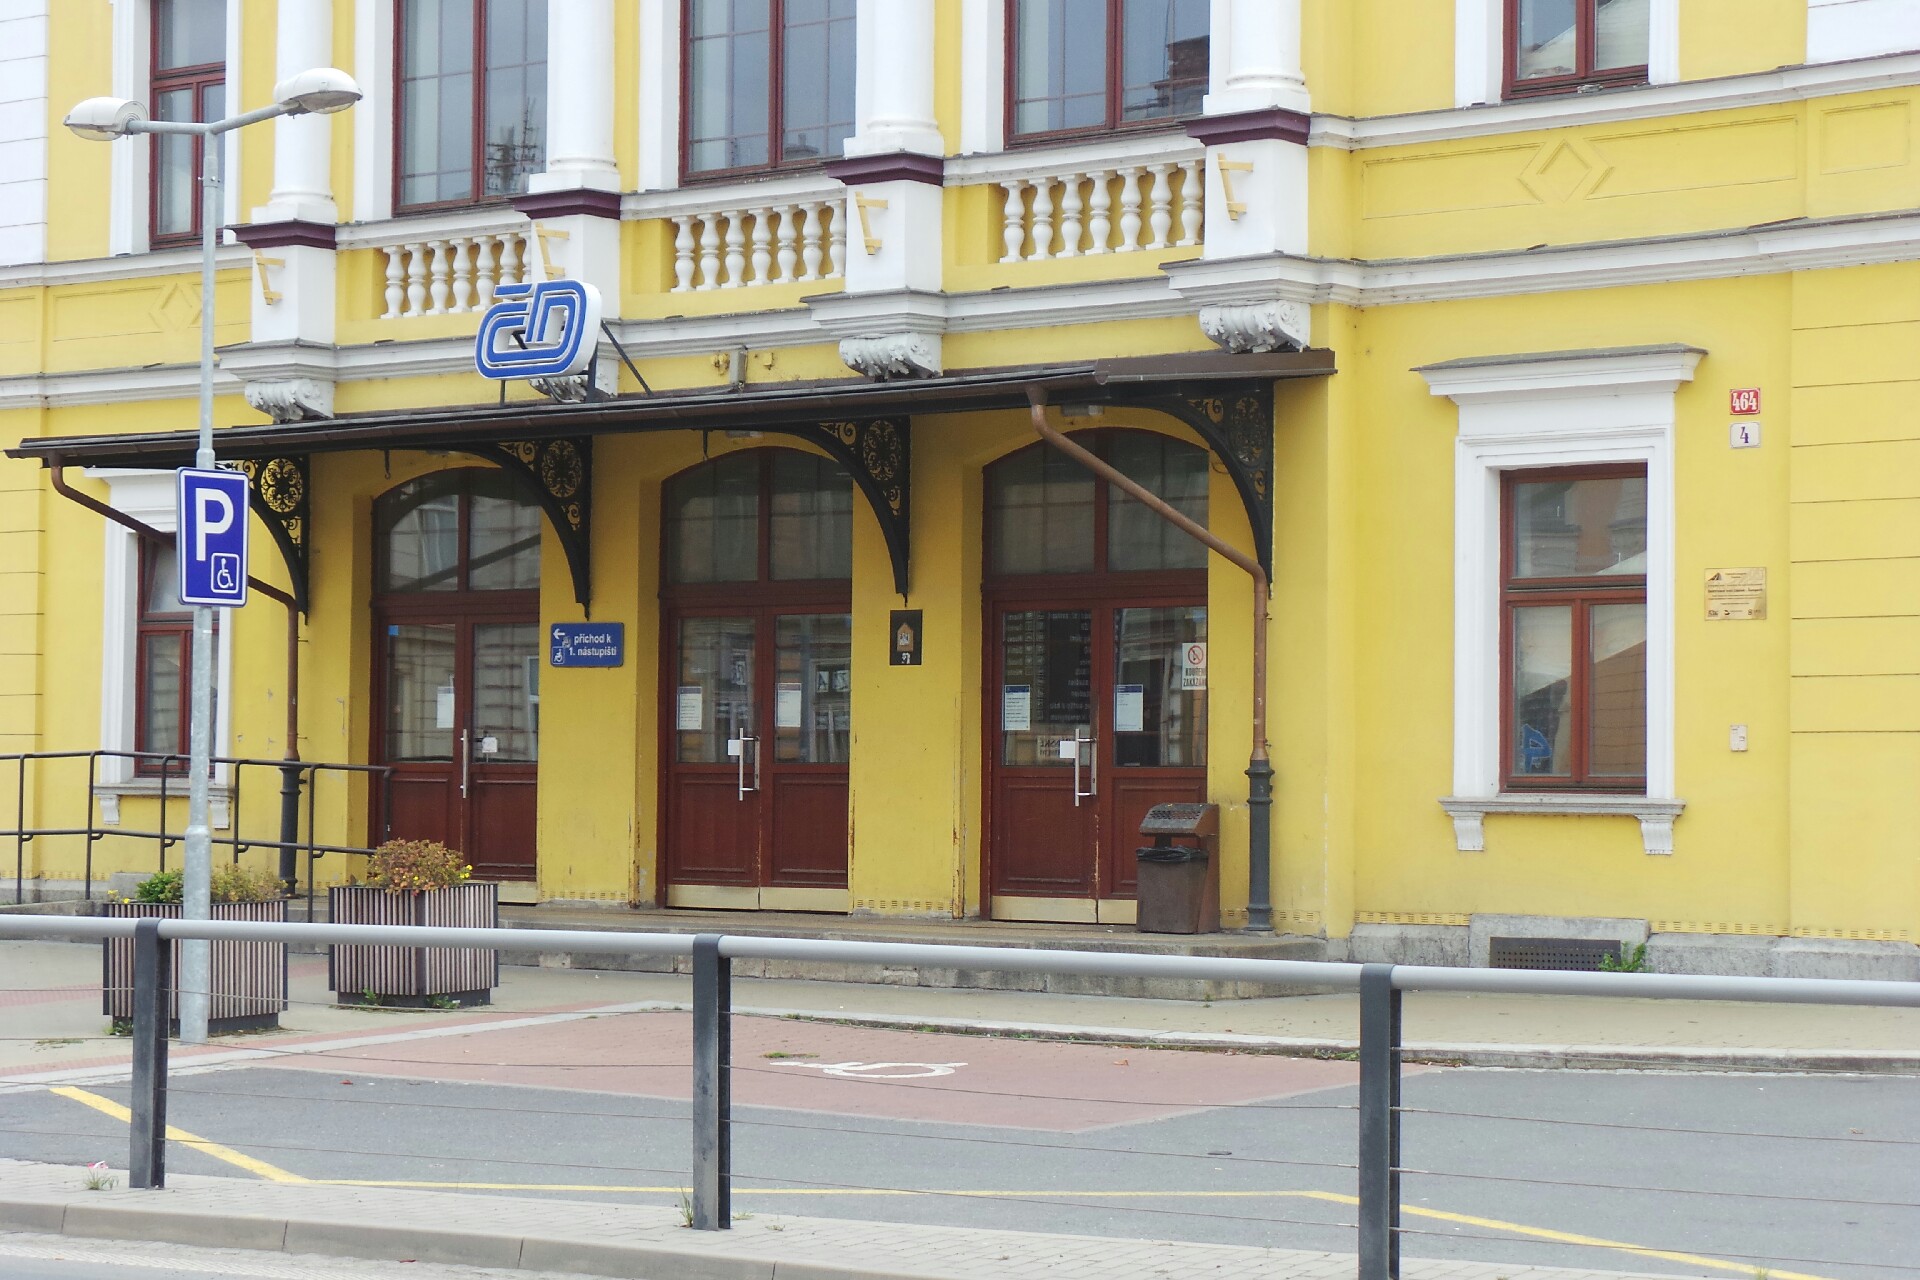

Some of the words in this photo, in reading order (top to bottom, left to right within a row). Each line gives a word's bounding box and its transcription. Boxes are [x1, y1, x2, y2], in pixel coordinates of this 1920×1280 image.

[1732, 391, 1757, 411] 464
[1739, 426, 1749, 443] 4
[195, 487, 235, 562] P
[574, 634, 605, 645] příchod
[606, 634, 611, 643] k
[569, 647, 575, 656] 1.
[577, 646, 617, 658] nástupišti
